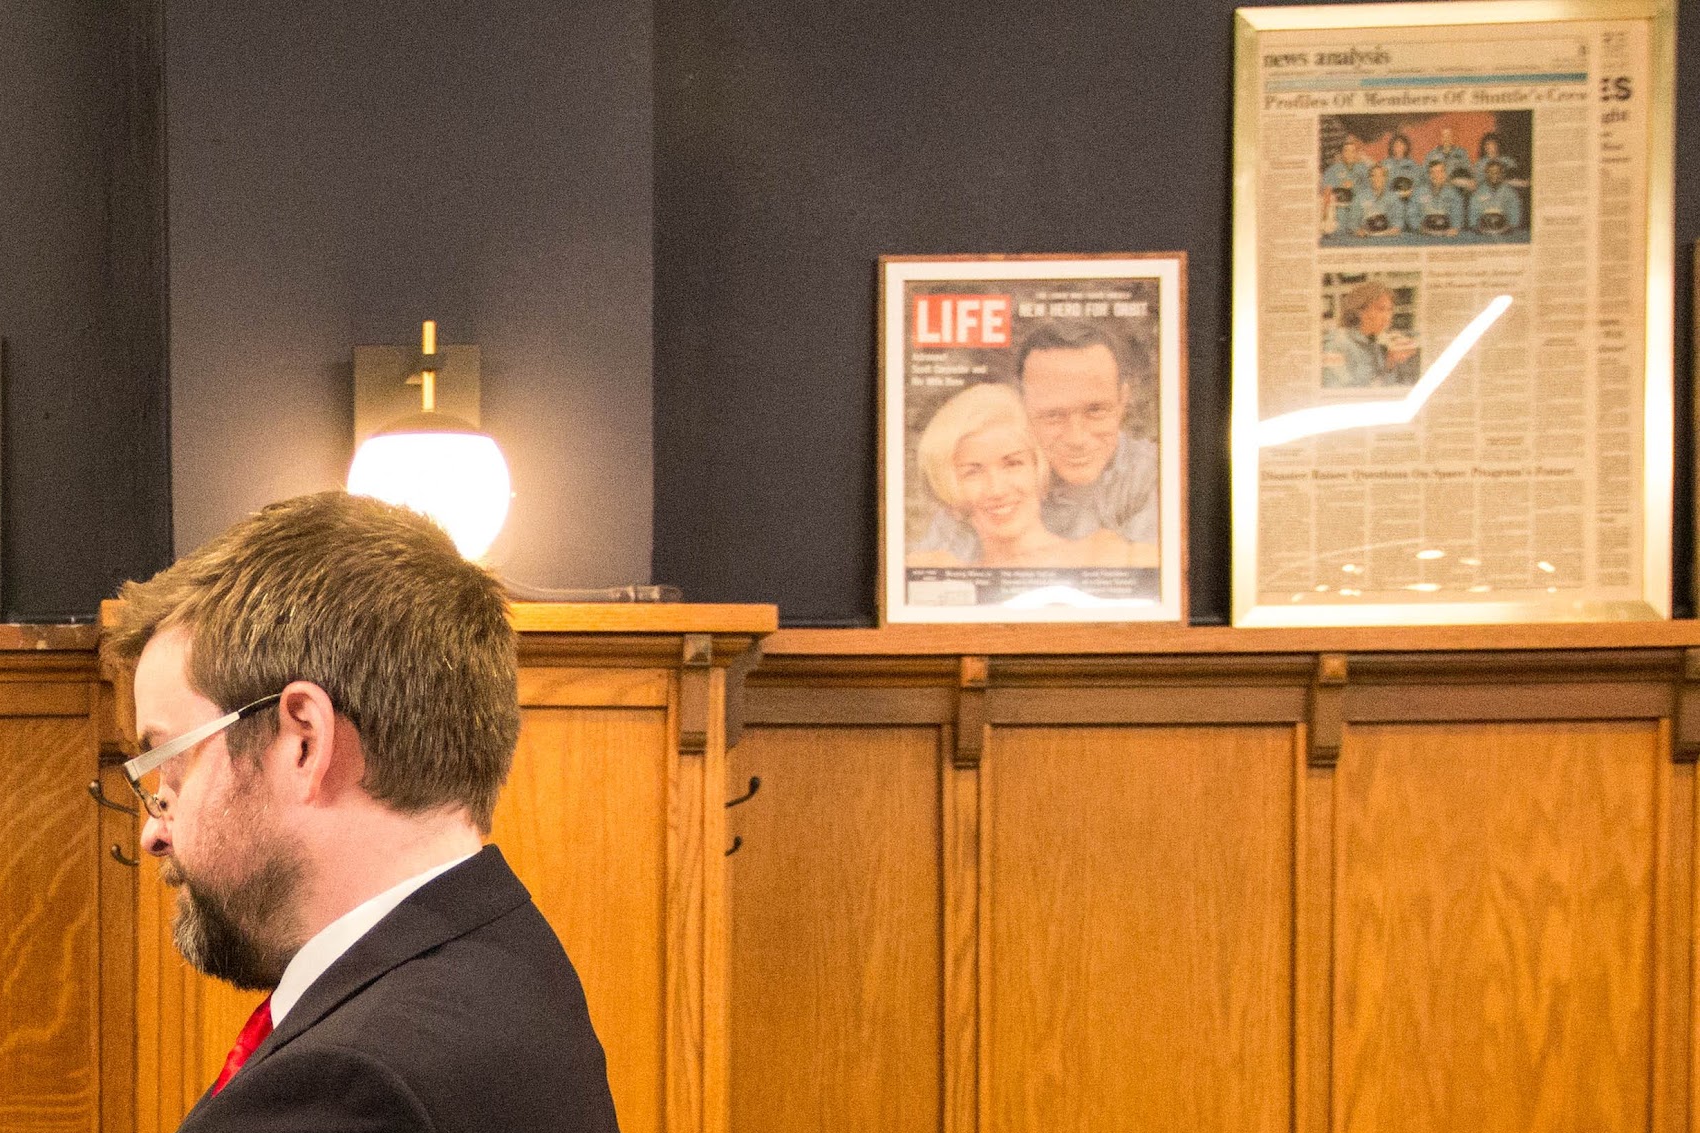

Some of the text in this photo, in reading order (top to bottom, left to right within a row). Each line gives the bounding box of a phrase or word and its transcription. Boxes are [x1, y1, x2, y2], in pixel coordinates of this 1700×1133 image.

[1264, 44, 1391, 69] news analysis
[916, 299, 1007, 343] LIFE
